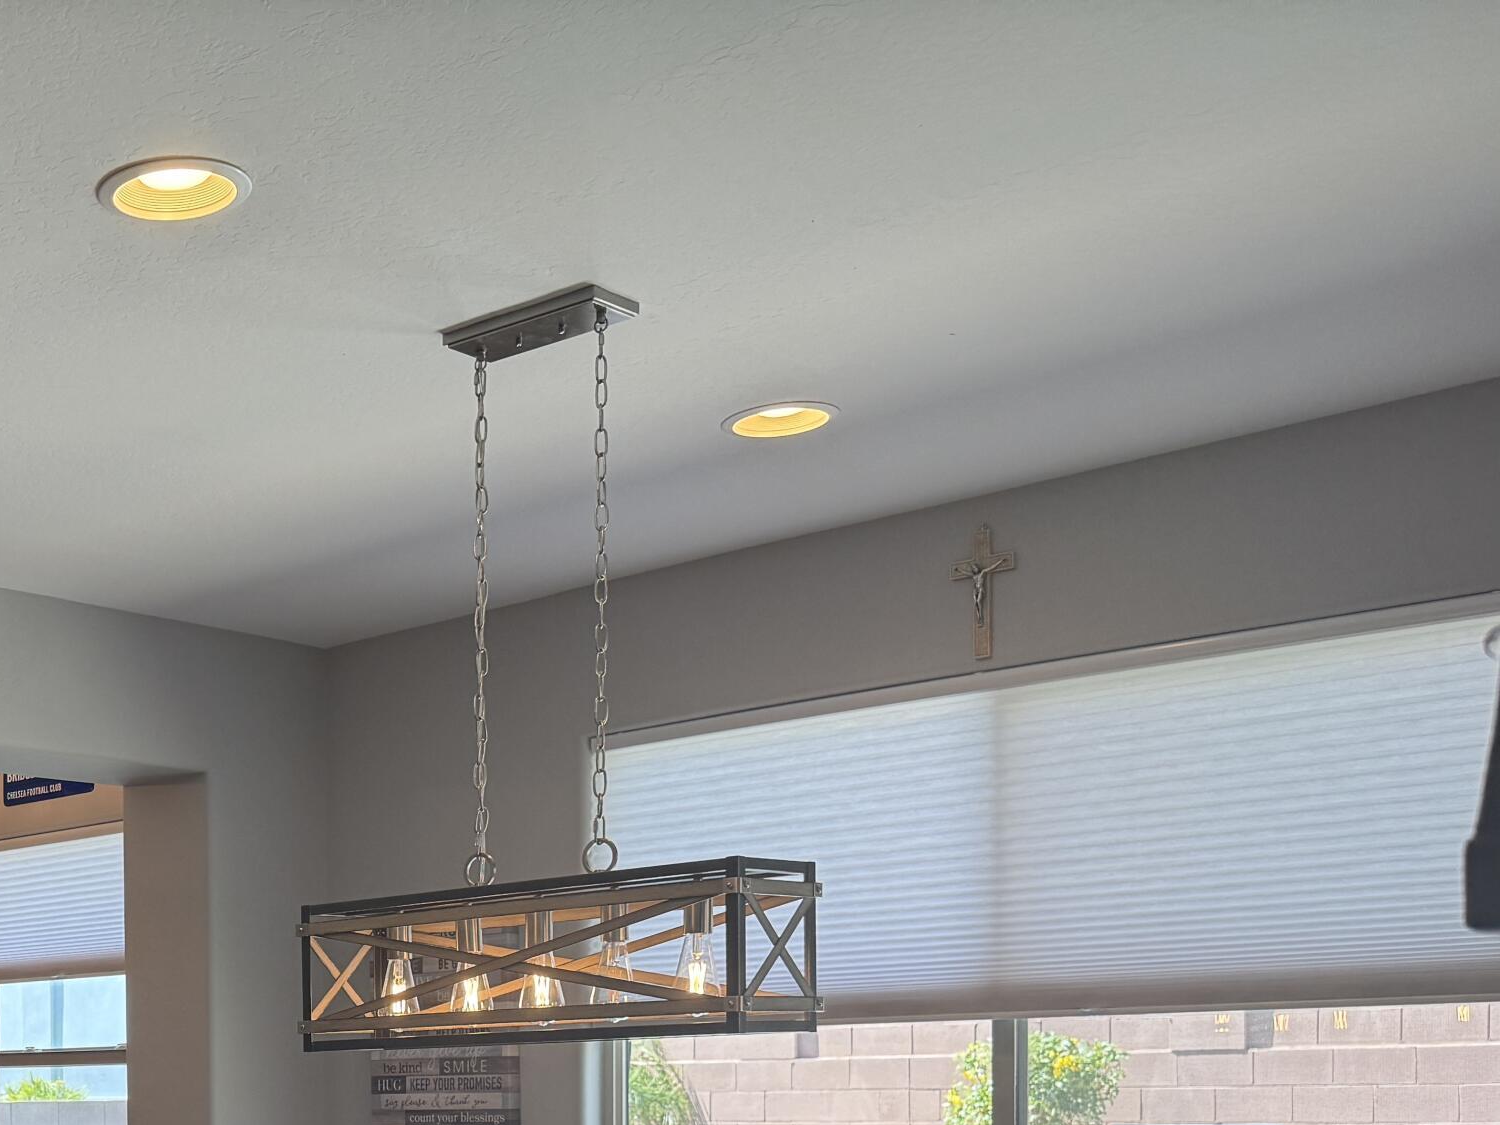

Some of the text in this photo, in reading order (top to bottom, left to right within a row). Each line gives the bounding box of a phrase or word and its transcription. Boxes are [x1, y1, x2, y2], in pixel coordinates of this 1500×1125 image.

[6, 783, 62, 801] CHELSEA FOOTBALL CLUB
[443, 1058, 488, 1074] SMILE
[377, 1079, 402, 1091] HUG
[410, 1076, 502, 1091] KEEP YOUR PROMISES
[409, 1111, 506, 1125] count your blessings
